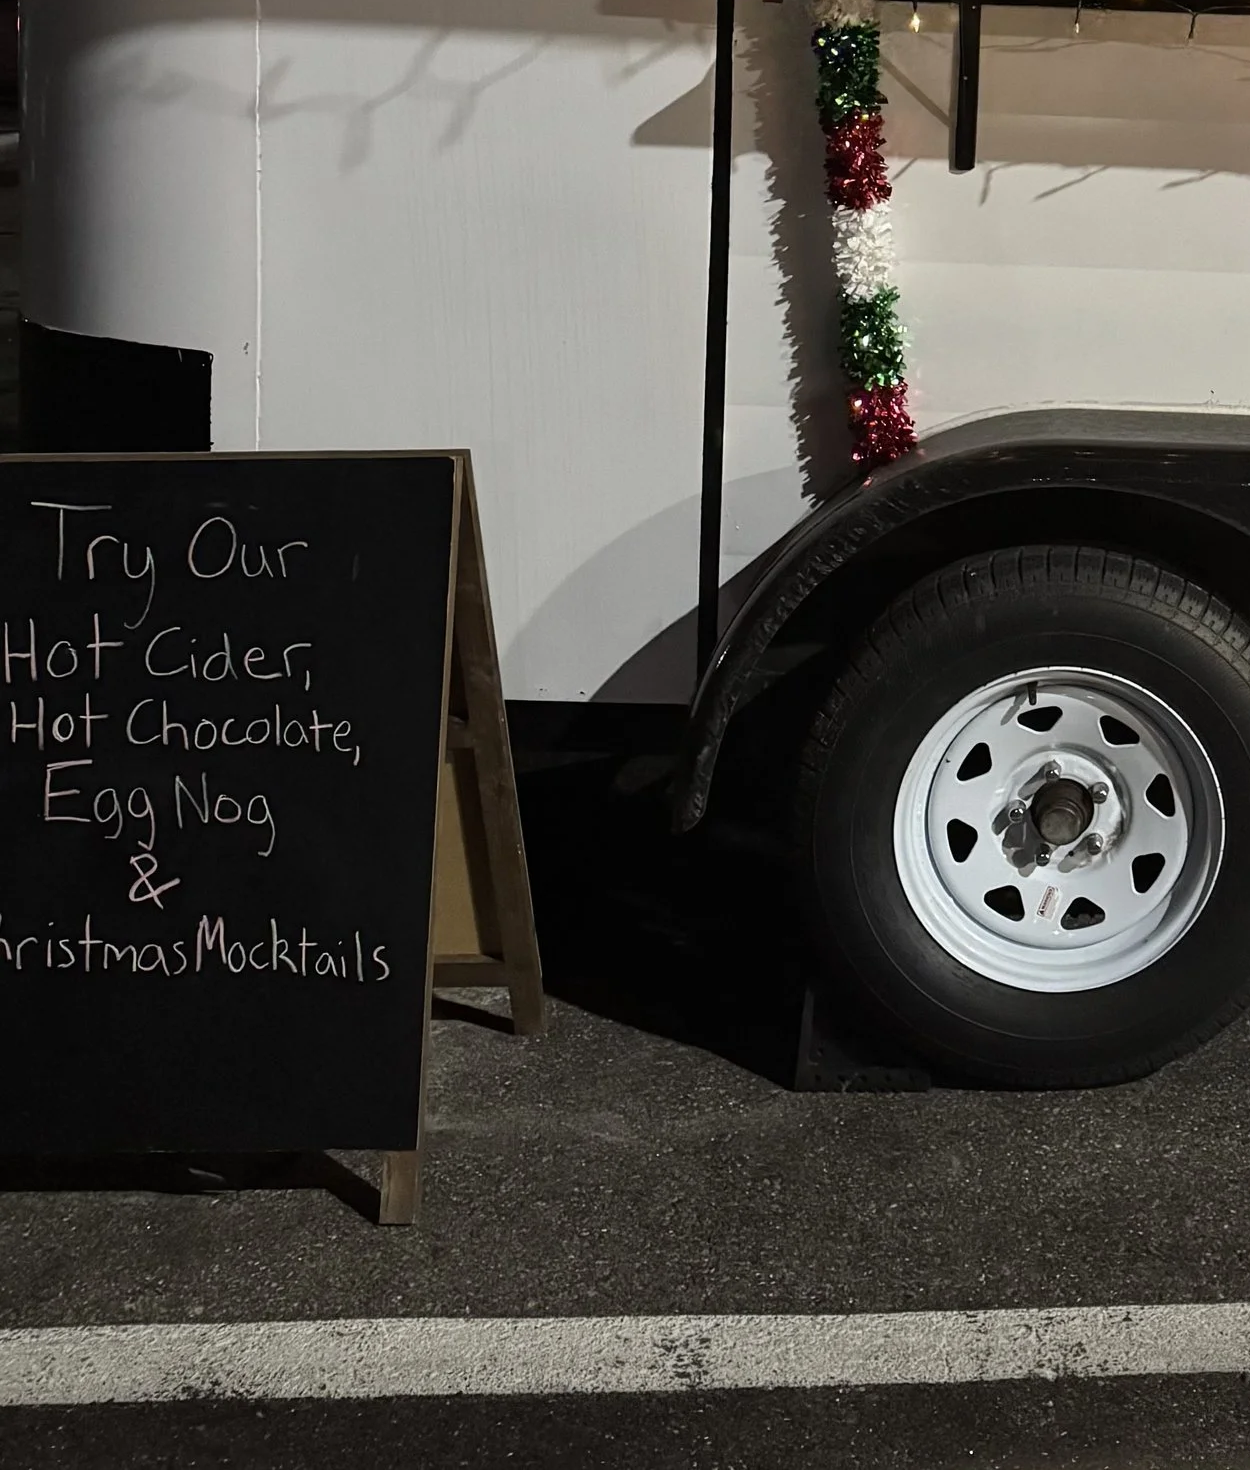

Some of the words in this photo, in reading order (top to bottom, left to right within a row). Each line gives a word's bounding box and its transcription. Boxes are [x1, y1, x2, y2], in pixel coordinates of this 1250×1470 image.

[31, 501, 156, 629] Try
[188, 516, 309, 580] Our
[3, 612, 124, 684] Hot
[144, 626, 313, 690] Cider,
[11, 696, 109, 748] Hot
[126, 698, 361, 765] Chocolate,
[44, 759, 155, 851] Egg
[174, 772, 276, 857] Nog
[127, 852, 181, 909] &
